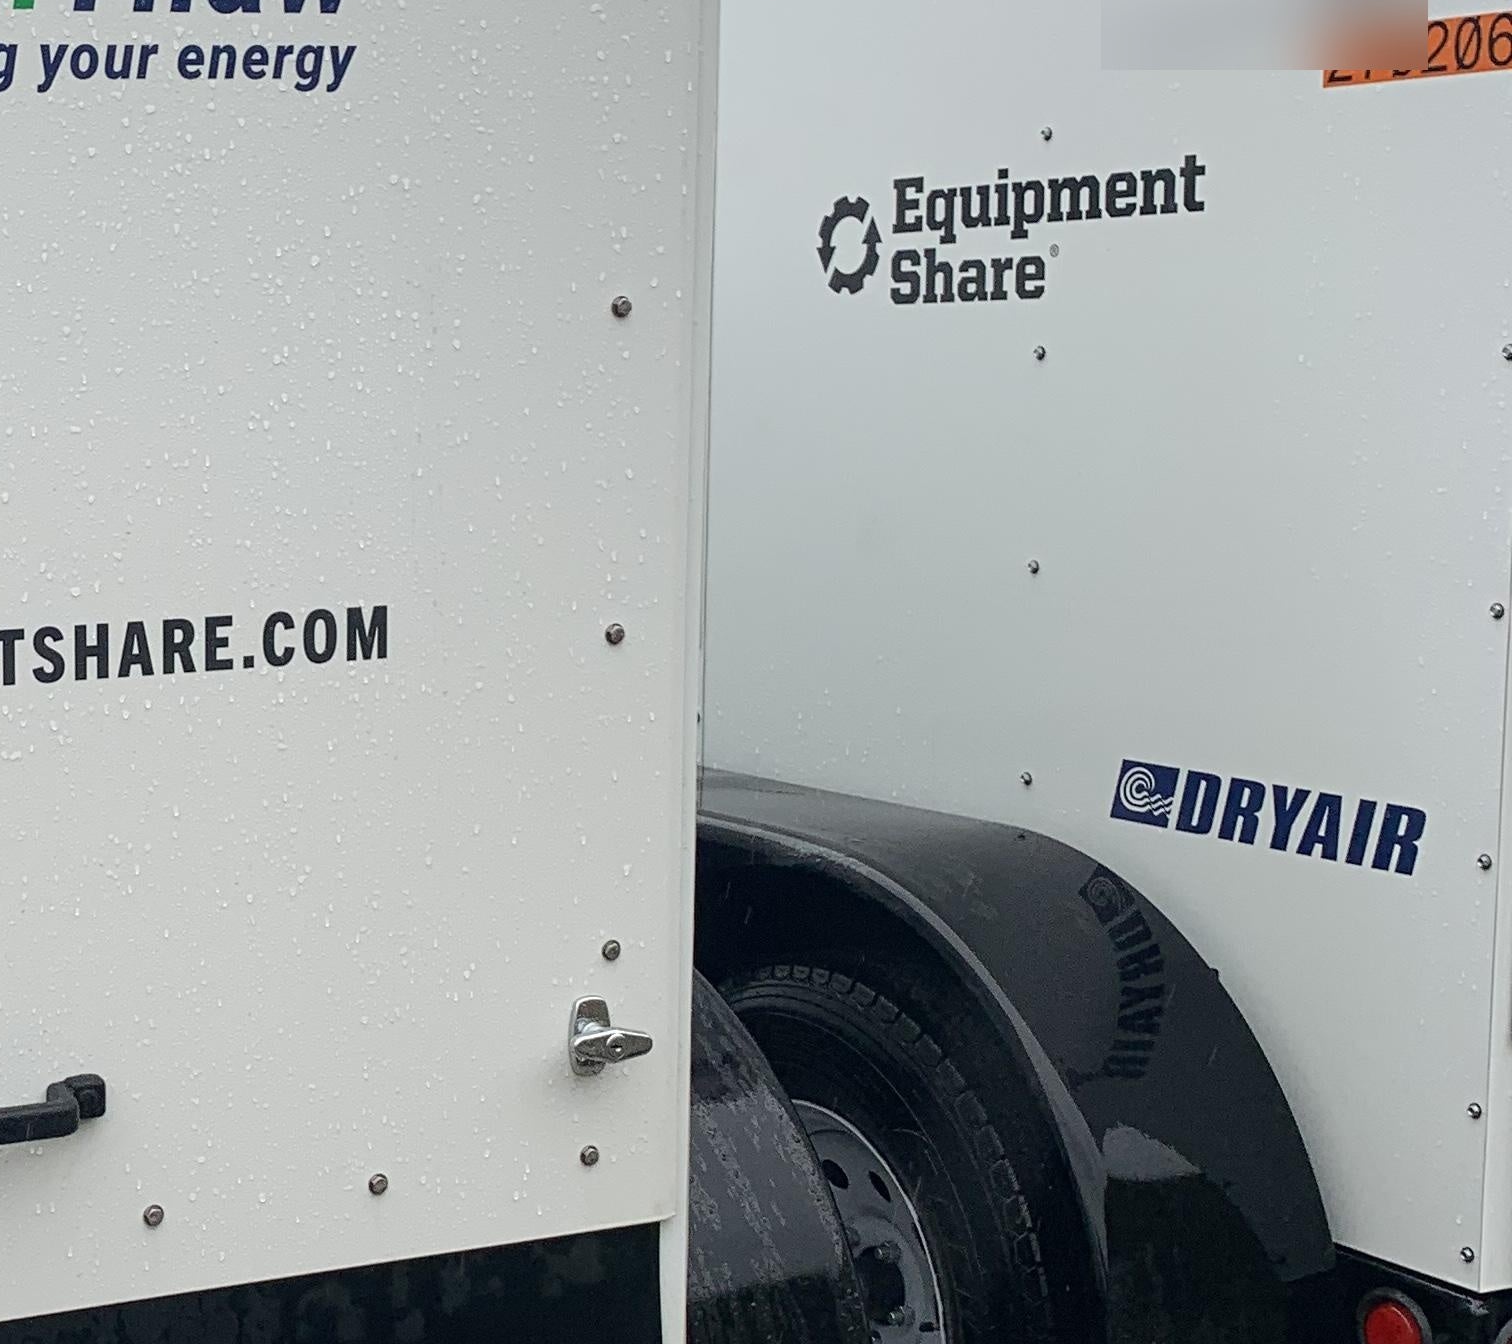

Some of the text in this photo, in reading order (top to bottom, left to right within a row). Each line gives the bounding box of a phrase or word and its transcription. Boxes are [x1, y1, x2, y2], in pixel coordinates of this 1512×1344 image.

[36, 43, 159, 94] your
[177, 44, 357, 93] energy
[892, 154, 1206, 244] Equipment
[1175, 769, 1427, 876] DRYAIR
